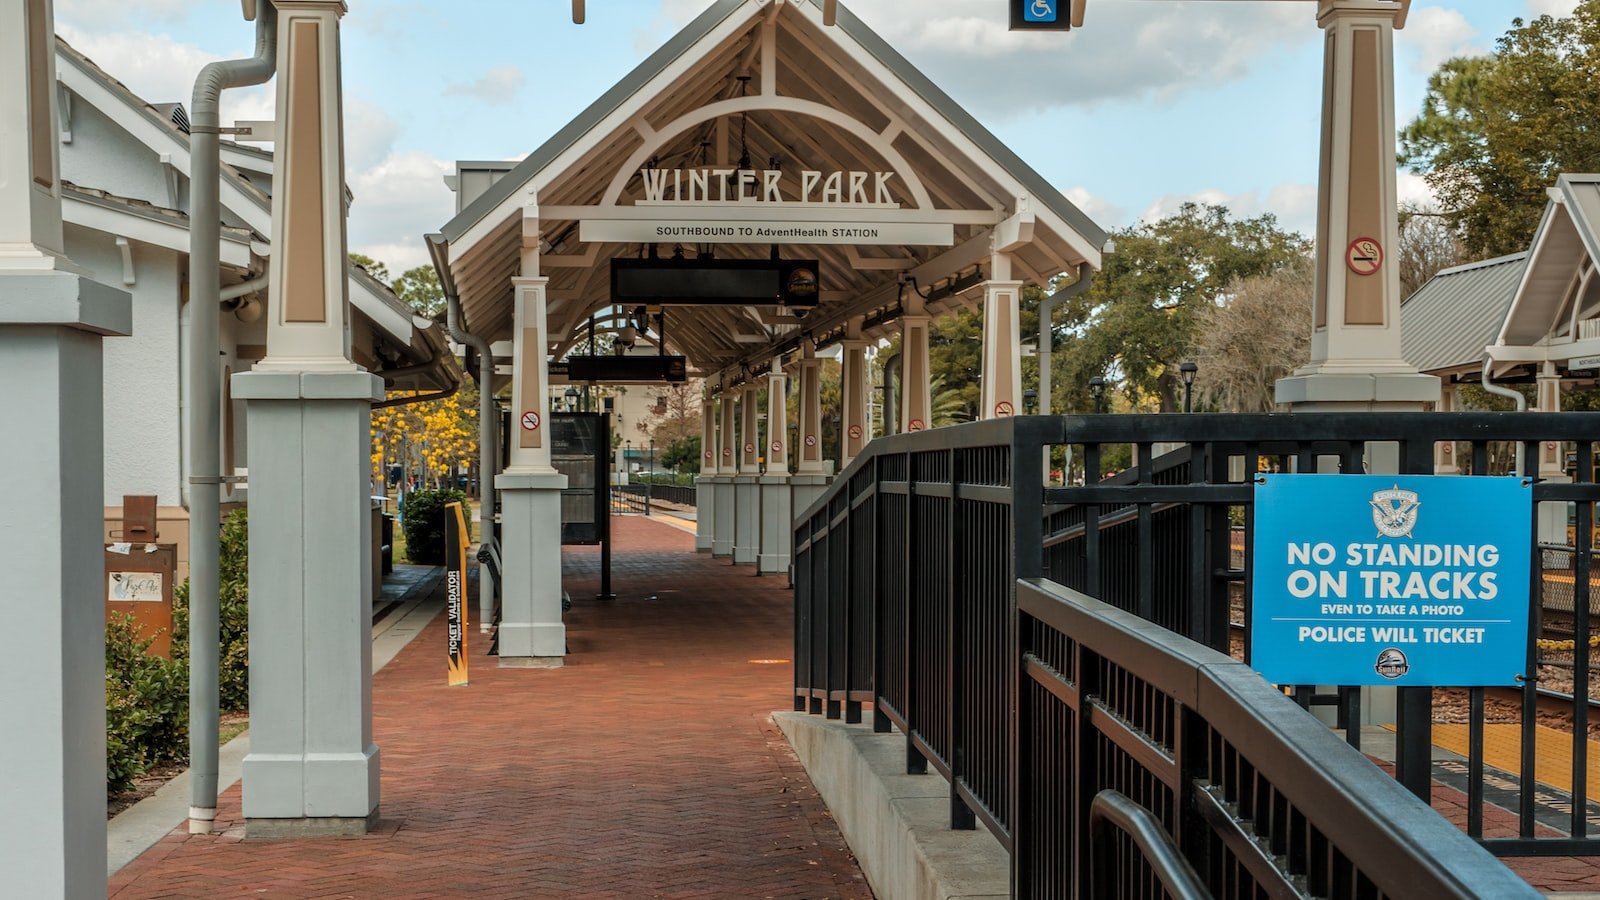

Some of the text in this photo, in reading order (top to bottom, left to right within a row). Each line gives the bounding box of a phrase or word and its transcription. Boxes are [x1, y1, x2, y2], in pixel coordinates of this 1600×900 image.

[641, 168, 895, 205] WINTER PARK
[656, 226, 879, 238] SOUTHBOUND TO AdventHealth STATION
[1287, 542, 1500, 568] NO STANDING
[1286, 569, 1498, 600] ON TRACKS
[448, 571, 458, 655] TICKET VALIDATOR
[1321, 604, 1464, 616] EVEN TO TAKE A PHOTO
[1299, 626, 1485, 644] POLICE WILL TICKET
[1378, 665, 1406, 673] SunRail
